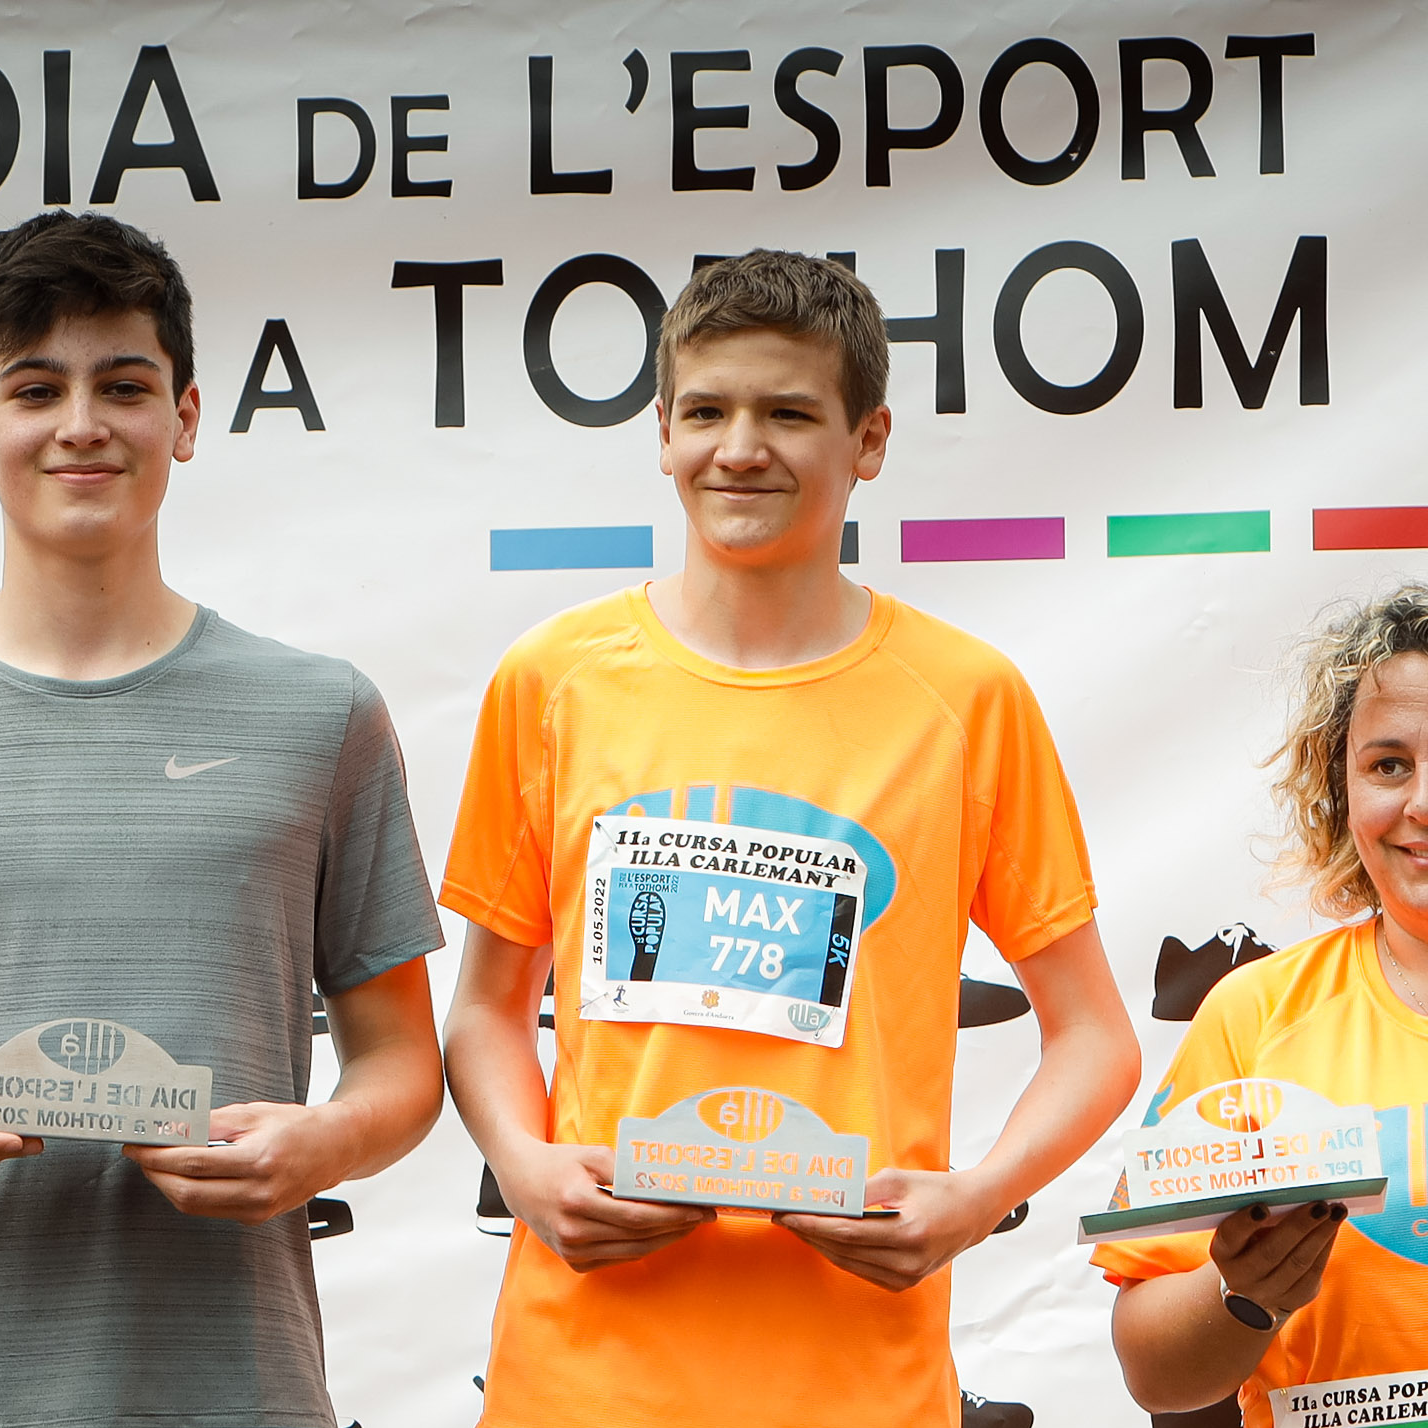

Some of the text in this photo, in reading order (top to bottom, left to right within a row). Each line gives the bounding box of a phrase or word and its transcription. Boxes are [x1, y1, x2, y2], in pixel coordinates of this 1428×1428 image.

[297, 94, 454, 201] DE
[528, 33, 1317, 195] L'ESPORT
[230, 235, 1330, 434] A TOHOM
[615, 829, 858, 875] 11a CURSA POPULAR
[629, 850, 842, 889] ILLA CARLEMANY
[627, 872, 671, 884] L'ESPORT
[634, 883, 670, 893] TOTHOM
[591, 877, 608, 966] 15.05.2022
[631, 893, 650, 937] CURSA
[702, 885, 805, 936] MAX
[708, 935, 786, 980] 778
[828, 933, 850, 969] 5K
[791, 1003, 821, 1026] illa
[1290, 1395, 1318, 1412] 11a
[1322, 1387, 1382, 1408] CURSA
